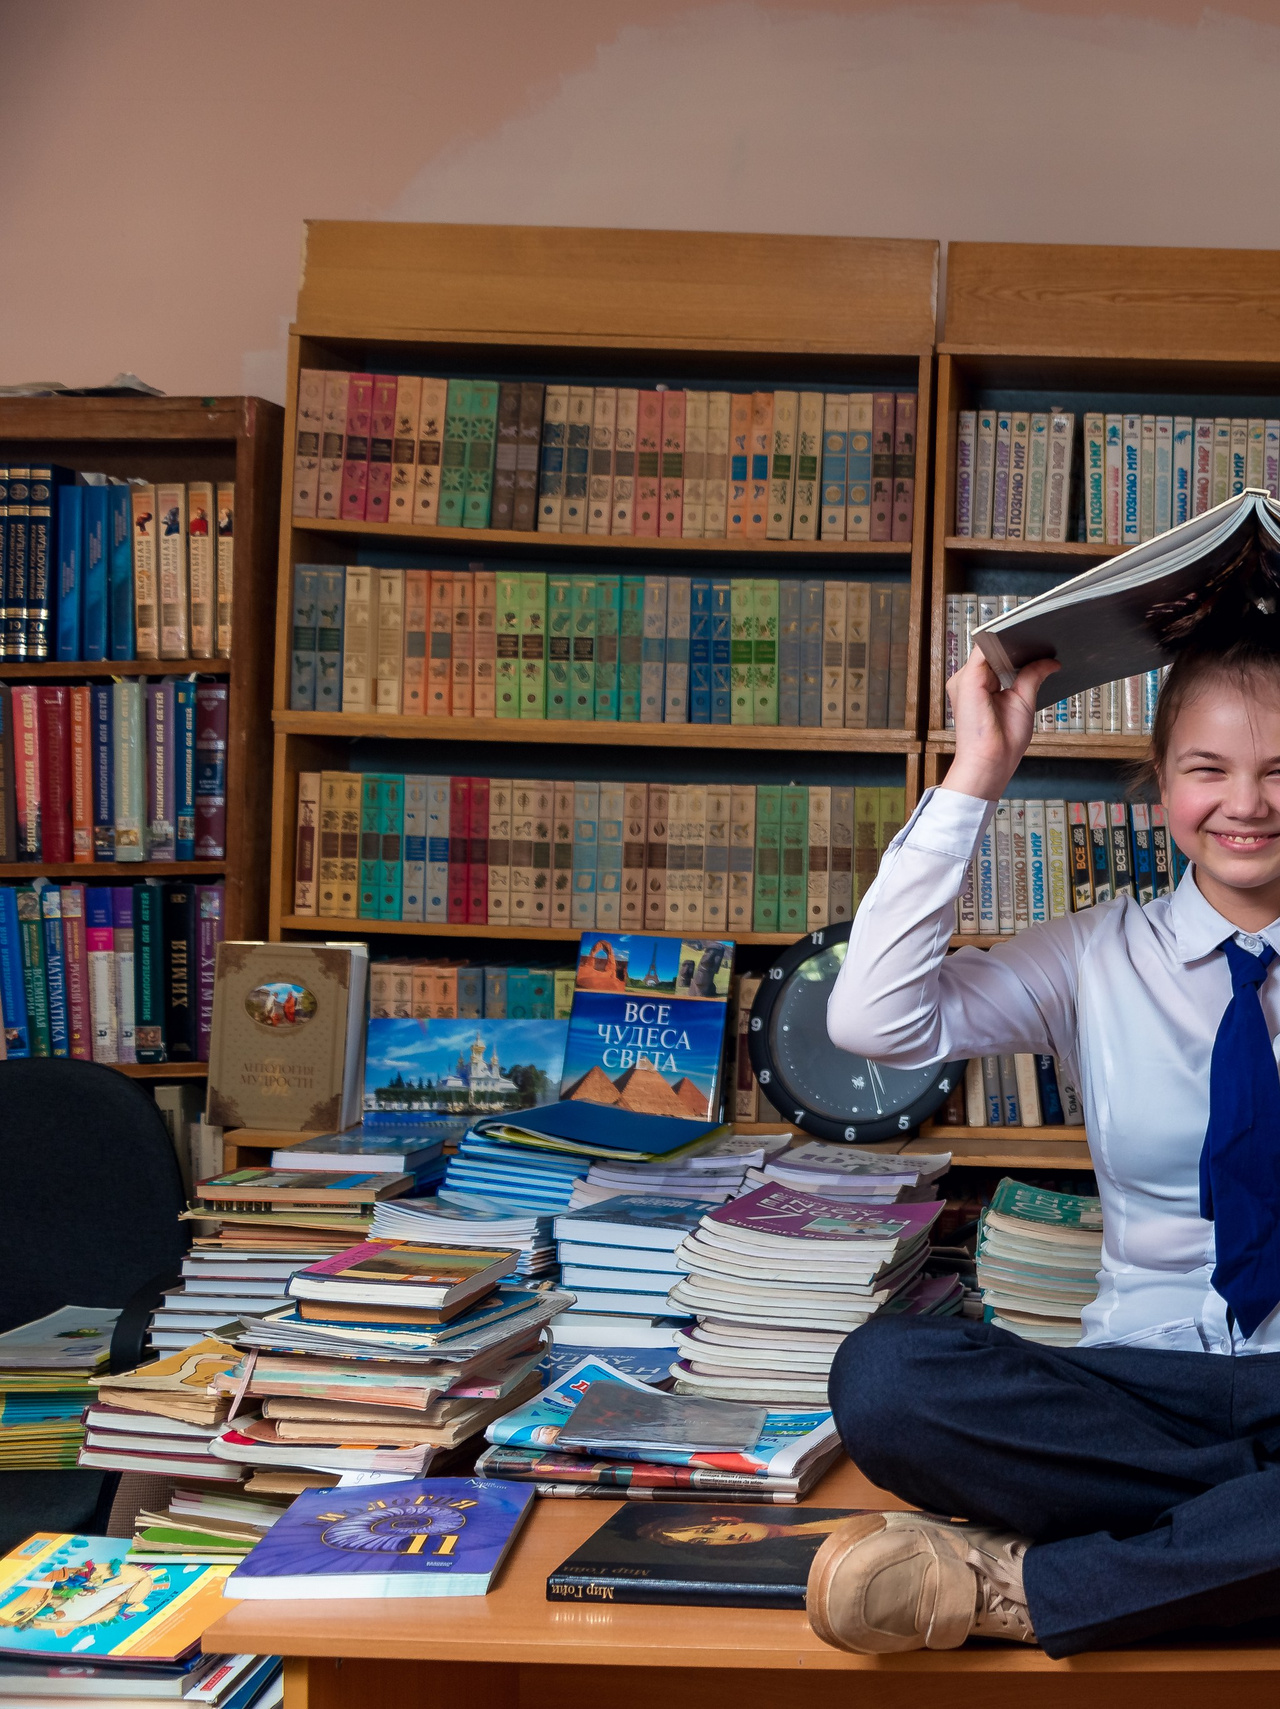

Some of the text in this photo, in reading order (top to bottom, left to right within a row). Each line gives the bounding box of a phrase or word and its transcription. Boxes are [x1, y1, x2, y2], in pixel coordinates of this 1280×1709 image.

[1008, 441, 1025, 538] Я ПОЗНАЮ МИР
[1089, 440, 1103, 538] Я ПОЗНАЮ МИР
[1124, 445, 1138, 534] Я ПОЗНАЮ МИР
[1196, 477, 1210, 516] ЗНАЮ
[16, 524, 25, 598] ЭНЦИКЛОПЕДИЯ
[37, 525, 46, 599] ЭНЦИКЛОПЕДИЯ
[162, 538, 171, 599] ШКОЛЬНАЯ
[192, 538, 200, 598] ШКОЛЬНАЯ
[73, 693, 82, 721] ДЕТЕЙ
[98, 693, 107, 720] ДЕТЕЙ
[155, 692, 163, 720] ДЕТЕЙ
[21, 693, 37, 852] ЭНЦИКЛОПЕДИЯ ДЛЯ ДЕТЕЙ
[75, 748, 83, 821] ЭНЦИКЛОПЕДИЯ
[100, 746, 108, 820] ЭНЦИКЛОПЕДИЯ
[156, 746, 164, 820] ЭНЦИКЛОПЕДИЯ
[1073, 803, 1082, 823] 1
[1091, 803, 1106, 828] 2
[1114, 804, 1122, 822] 3
[1136, 805, 1147, 826] 4
[1154, 805, 1164, 825] 5
[1076, 847, 1085, 869] ВСЕ
[1096, 847, 1105, 869] ВСЕ
[1116, 849, 1126, 871] ВСЕ
[1139, 850, 1148, 872] ВСЕ
[1156, 850, 1166, 872] ВСЕ
[1031, 832, 1044, 909] ПОЗНАЮ МИР
[140, 892, 149, 921] ДЕТЕЙ
[811, 932, 824, 945] 11
[142, 947, 150, 1020] ЭНЦИКЛОПЕДИЯ
[171, 940, 188, 1007] ХИМИЯ
[769, 969, 783, 980] 10
[24, 969, 35, 1016] ИСТОРИЯ
[33, 968, 46, 1028] ВСЕМИРНАЯ
[48, 955, 65, 1041] МАТЕМАТИКА
[71, 963, 83, 1030] РУССКИЙ ЯЗЫК
[624, 1002, 671, 1025] ВСЕ
[751, 1018, 762, 1031] 9
[598, 1024, 691, 1050] ЧУДЕСА
[243, 1062, 315, 1076] АНТОЛОГИЯ
[602, 1048, 678, 1072] СВЕТА
[240, 1074, 313, 1088] МУДРОСТИ
[759, 1070, 771, 1083] 8
[939, 1079, 951, 1091] 4
[794, 1111, 806, 1124] 7
[898, 1116, 910, 1129] 5
[844, 1127, 856, 1141] 6
[746, 1203, 803, 1220] 7
[760, 1199, 912, 1226] ENGLISH
[768, 1193, 882, 1217] ENJOY
[726, 1218, 845, 1241] Student's Book
[401, 1534, 460, 1555] 11
[612, 1568, 651, 1576] Мир
[551, 1583, 614, 1599] Мир Гойи
